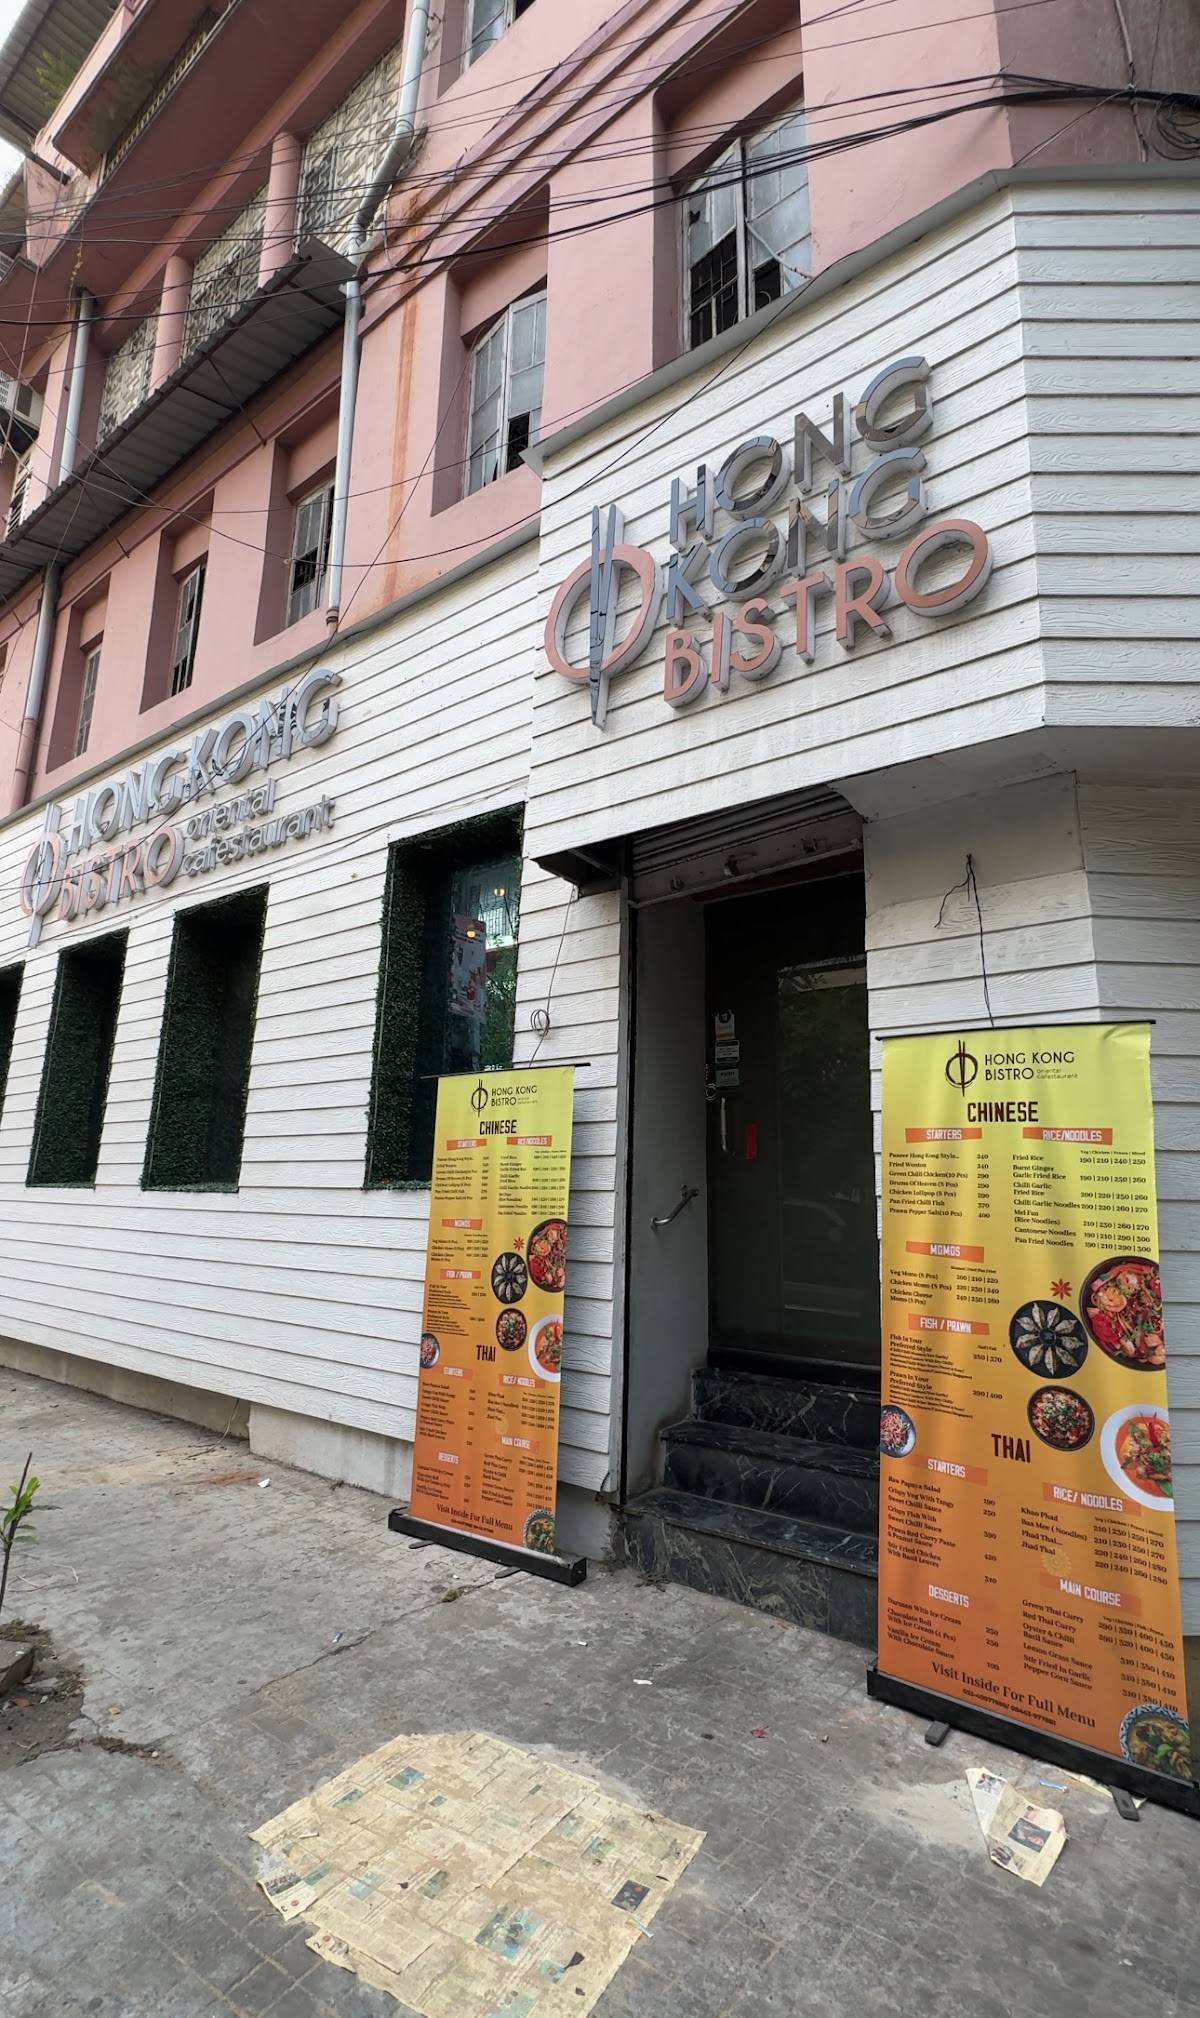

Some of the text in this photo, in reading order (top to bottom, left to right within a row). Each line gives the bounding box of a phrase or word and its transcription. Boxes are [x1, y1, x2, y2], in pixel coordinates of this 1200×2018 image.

[670, 356, 933, 553] HONG
[666, 446, 927, 627] KONG
[664, 519, 993, 708] BISTRO
[186, 778, 276, 839] oriental
[59, 825, 184, 921] BISTRO
[985, 1051, 1075, 1065] HONG KONG
[985, 1068, 1033, 1080] BISTRO
[491, 1085, 537, 1096] HONG KONG
[491, 1097, 517, 1107] BISTRO
[967, 1102, 1039, 1122] CHINESE
[480, 1120, 517, 1135] CHINESE
[926, 1130, 962, 1140] STARTERS
[1042, 1129, 1102, 1141] RICE/NOODLES
[1048, 1229, 1076, 1237] Noodles
[930, 1244, 960, 1256] MOMOS
[920, 1317, 971, 1333] FISH PRAWN
[476, 1345, 496, 1361] THAI
[890, 1341, 915, 1350] Preferred
[991, 1433, 1031, 1463] THAI
[928, 1459, 965, 1478] STARTERS
[888, 1486, 905, 1497] Crispy
[923, 1485, 940, 1493] Salad
[905, 1500, 922, 1508] Chilli
[924, 1504, 942, 1513] Sauce
[1053, 1486, 1123, 1511] RICE/ NOODLES
[437, 1504, 450, 1513] Visit
[451, 1508, 469, 1518] Inside
[470, 1513, 480, 1521] For
[482, 1515, 494, 1525] Full
[495, 1520, 512, 1530] Menu
[888, 1506, 936, 1522] Crispy Fish With
[1041, 1513, 1058, 1522] Phad
[920, 1533, 937, 1543] Curry
[1022, 1530, 1039, 1540] Phad
[1041, 1546, 1055, 1555] Thai
[1150, 1539, 1164, 1548] 270
[1151, 1551, 1165, 1560] 270
[929, 1584, 969, 1608] DESSERTS
[1060, 1579, 1120, 1607] MAIN COURSE
[1023, 1600, 1084, 1624] Green Thai Curry
[1023, 1611, 1076, 1633] Red Thai Curry
[1023, 1623, 1075, 1643] Oyster Chilli
[1023, 1631, 1063, 1647] Basil Sauce
[1024, 1643, 1092, 1670] Lemon Grass Sauce
[1024, 1654, 1091, 1681] Stir Fried In Garlic
[1024, 1662, 1092, 1690] Pepper Corn Sauce
[932, 1661, 960, 1680] Visit
[961, 1671, 1000, 1694] Inside
[1002, 1686, 1025, 1702] For
[1028, 1694, 1054, 1714] Full
[1057, 1704, 1096, 1728] Menu
